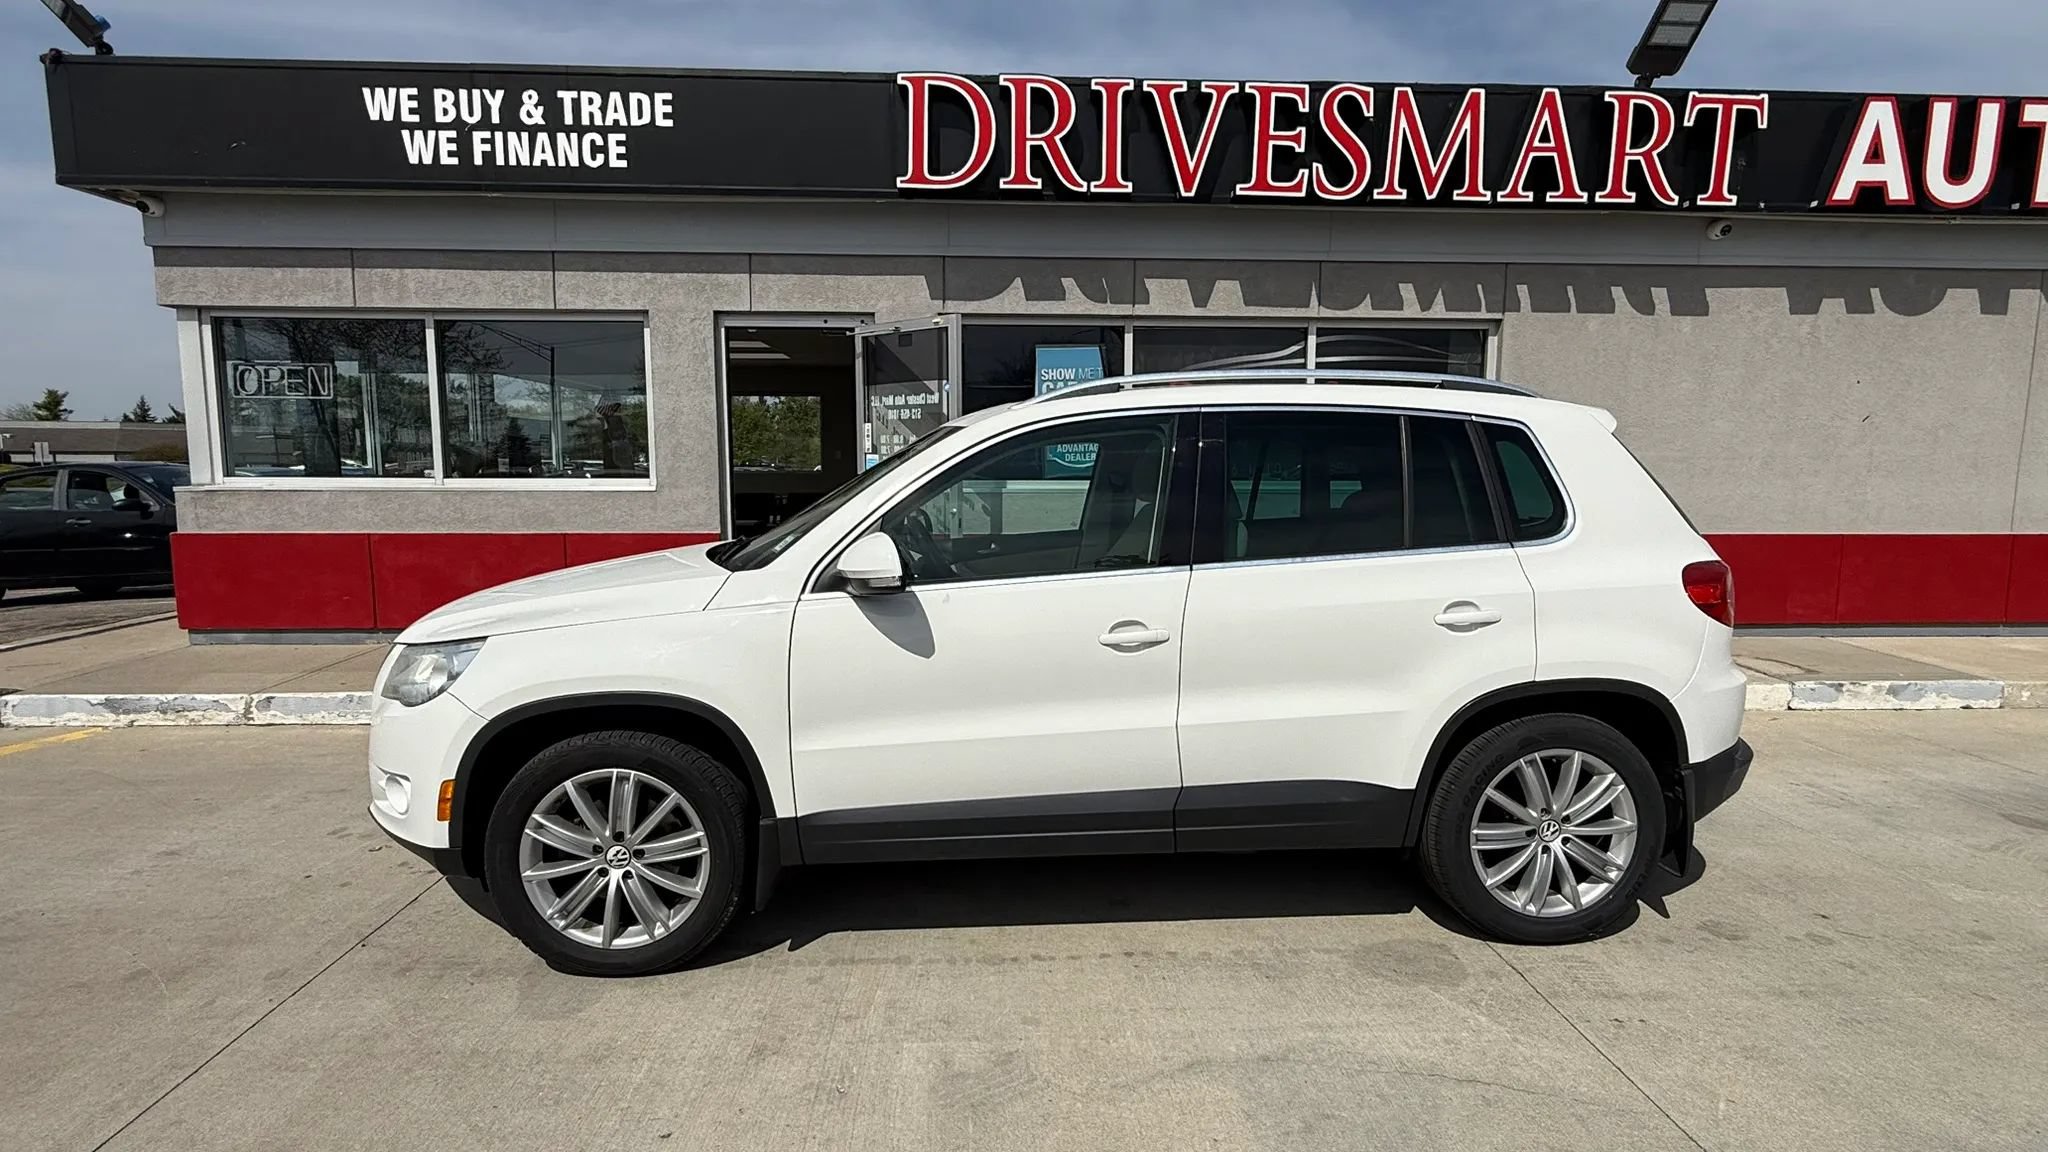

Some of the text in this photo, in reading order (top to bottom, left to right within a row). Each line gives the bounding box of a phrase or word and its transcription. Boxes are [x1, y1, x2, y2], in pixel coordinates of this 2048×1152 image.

[362, 87, 674, 127] WE BUY & TRADE
[401, 129, 628, 168] WE FINANCE
[896, 71, 1768, 206] DRIVESMART
[236, 366, 328, 395] OPEN
[1041, 368, 1076, 380] SHOW
[1079, 367, 1095, 379] ME
[1057, 443, 1099, 453] ADVANTAG
[1065, 452, 1097, 462] DEALER
